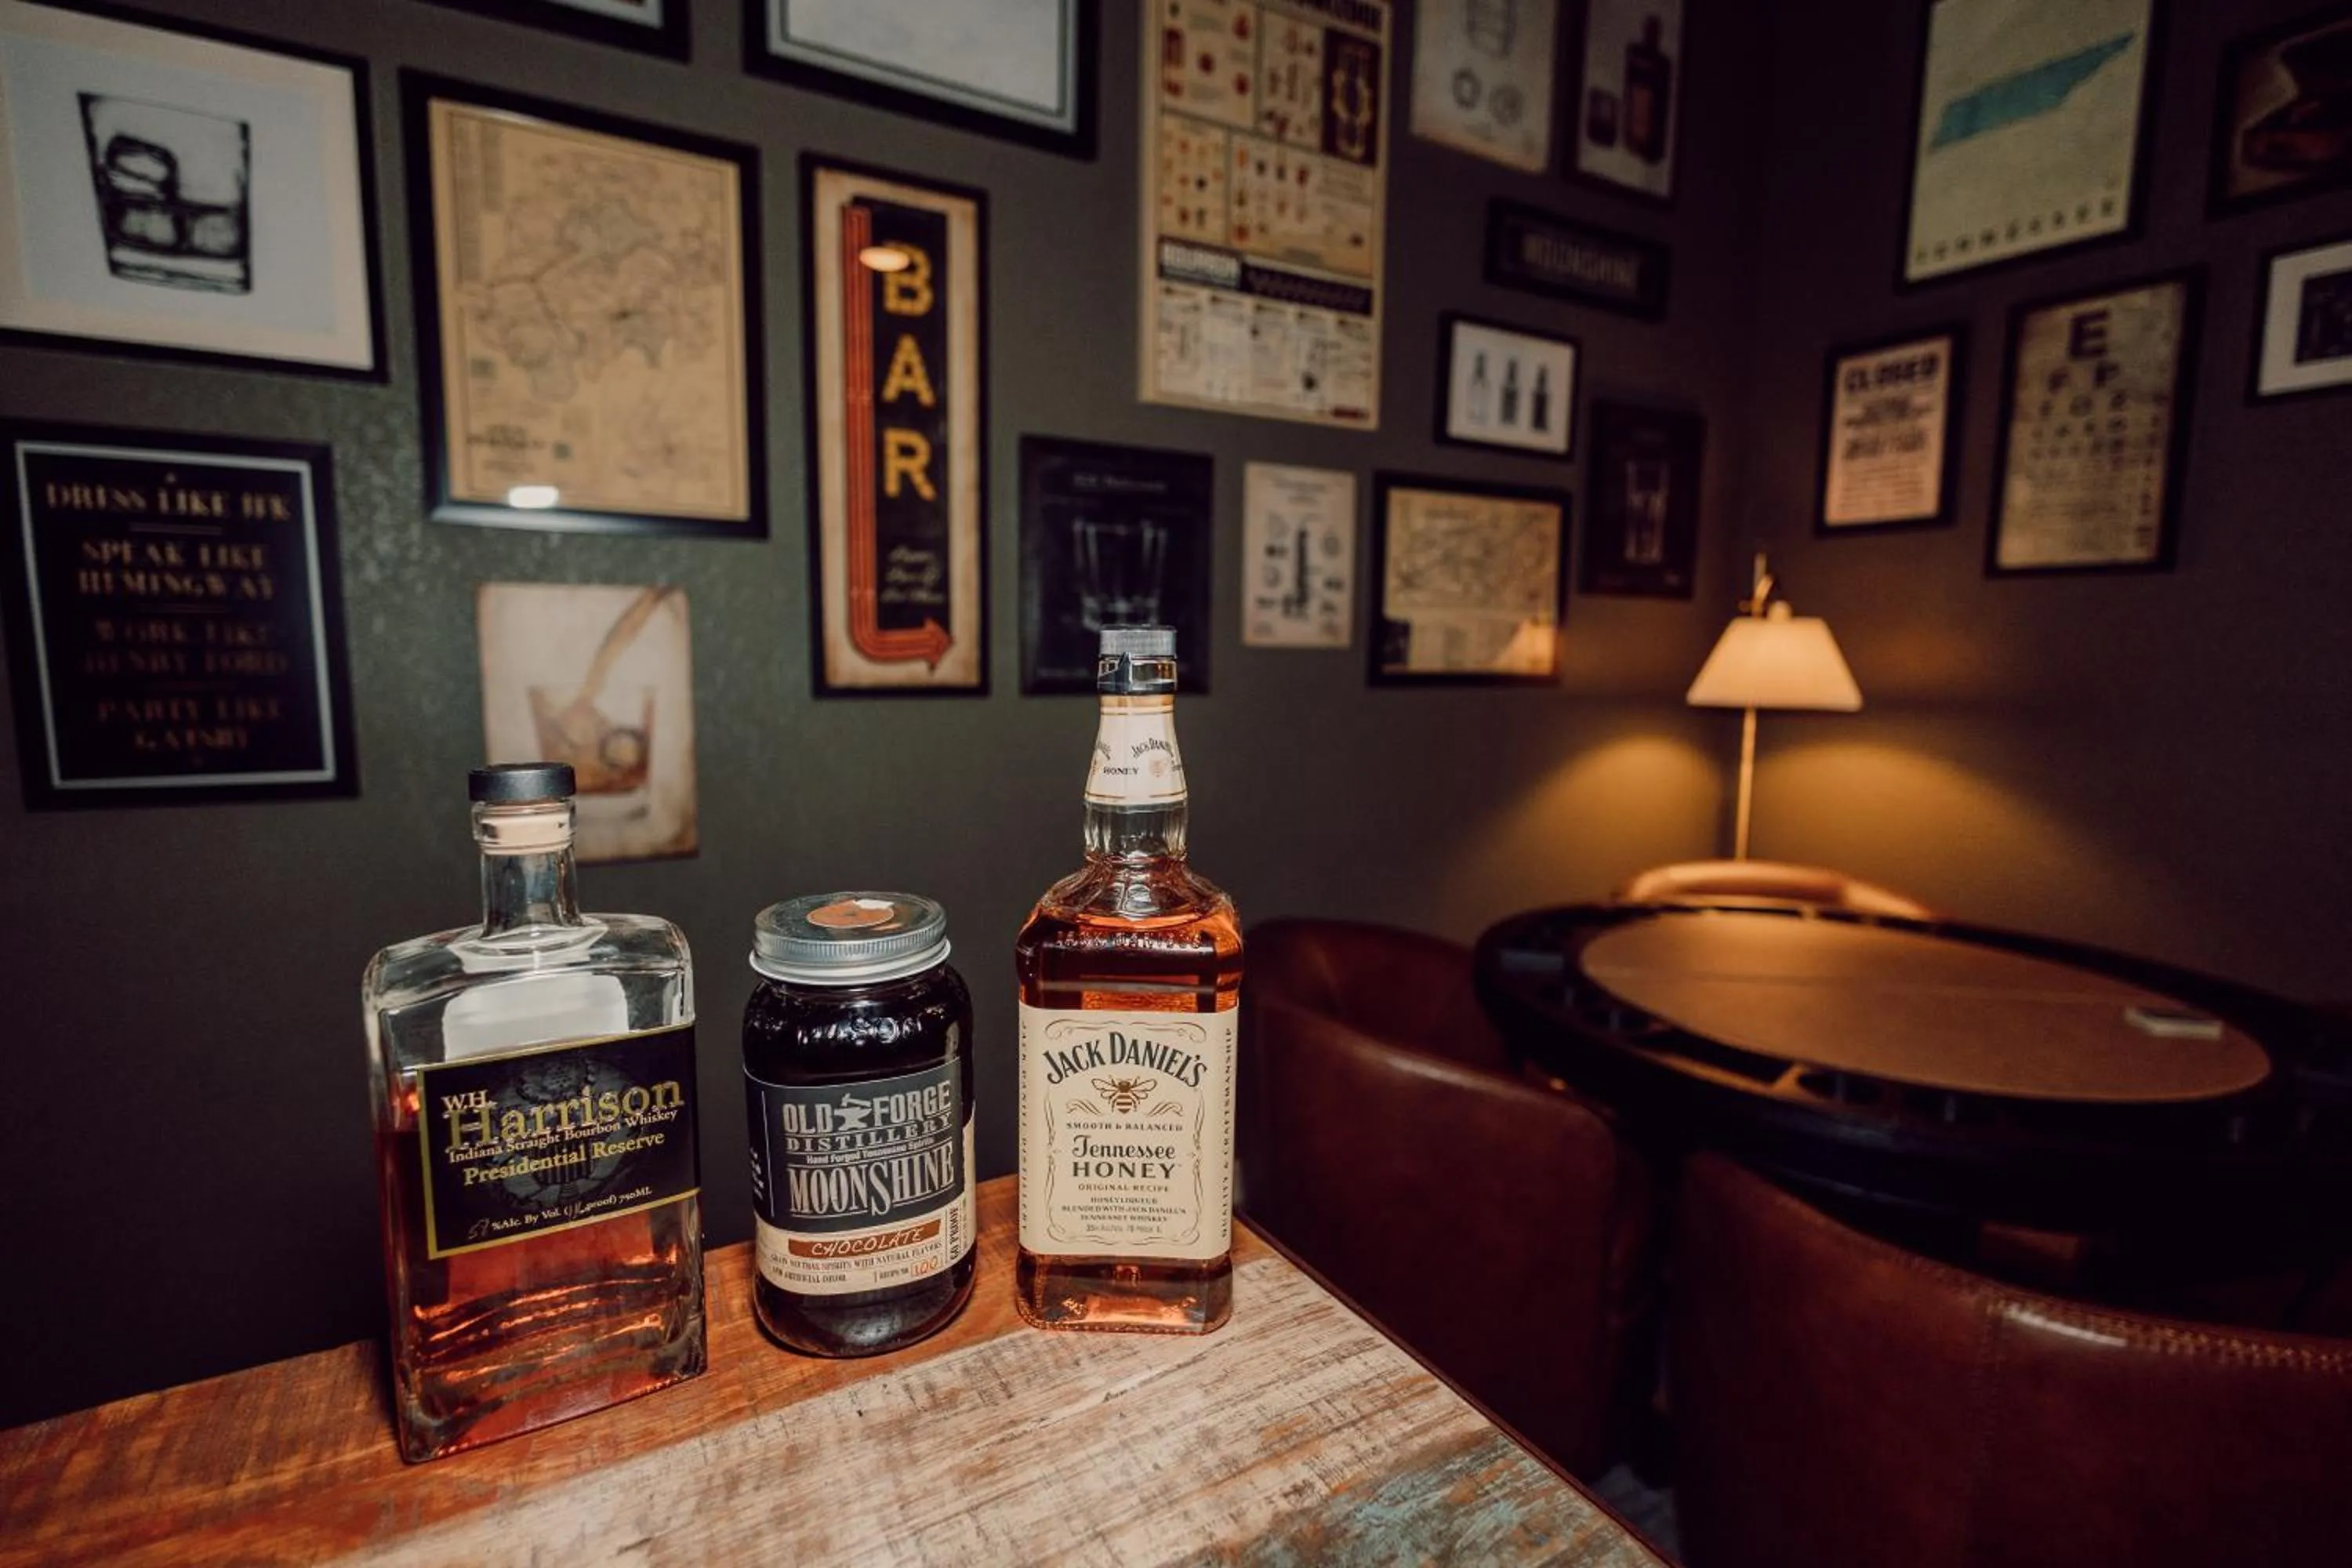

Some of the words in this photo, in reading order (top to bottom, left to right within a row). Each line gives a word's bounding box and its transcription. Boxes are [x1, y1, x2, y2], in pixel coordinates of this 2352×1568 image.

[2069, 308, 2110, 359] E
[881, 240, 936, 502] BAR
[1103, 766, 1139, 775] HONEY
[1043, 1039, 1106, 1084] JACK
[1109, 1031, 1207, 1088] DANIEL'S
[442, 1080, 685, 1154] Harrison
[782, 1103, 834, 1134] OLD
[873, 1080, 952, 1125] FORGE
[1124, 1123, 1183, 1131] BALANCED
[448, 1143, 503, 1163] Indiana
[506, 1133, 560, 1152] Straight
[564, 1120, 621, 1141] Bourbon
[624, 1106, 678, 1129] Whiskey
[786, 1112, 953, 1152] DISTILLERY
[1072, 1134, 1176, 1160] Tennessee
[463, 1144, 586, 1186] Presidential
[591, 1131, 666, 1160] Reserve
[786, 1141, 955, 1216] MOONSHINE
[1072, 1161, 1178, 1179] HONEY
[1133, 1184, 1169, 1192] RECIPE
[524, 1213, 539, 1225] By
[811, 1226, 925, 1257] CHOCOLATE
